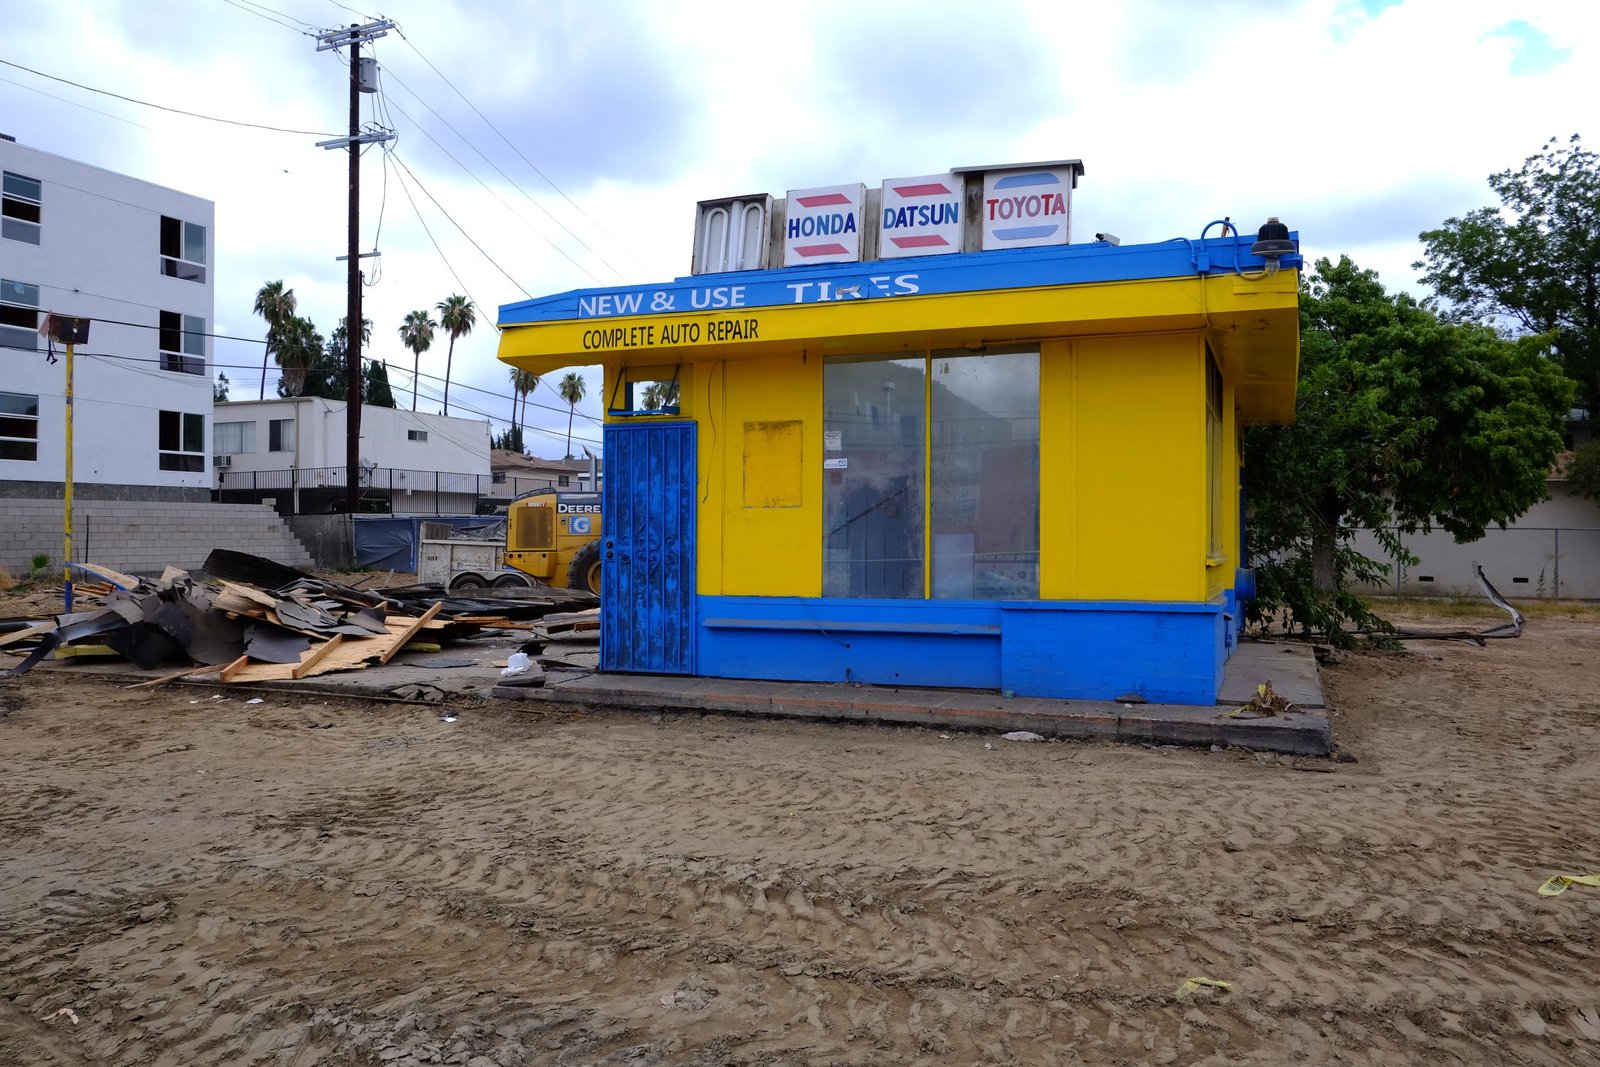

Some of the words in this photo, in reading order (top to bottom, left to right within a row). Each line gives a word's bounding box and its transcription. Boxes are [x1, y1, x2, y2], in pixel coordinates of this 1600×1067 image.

[883, 202, 959, 230] DATSUN
[986, 193, 1065, 221] TOYOTA
[788, 212, 857, 239] HONDA
[579, 291, 643, 317] NEW
[653, 291, 676, 313] &
[691, 286, 746, 309] USE
[583, 325, 654, 350] COMPLETE
[660, 323, 700, 345] AUTO
[707, 319, 759, 342] REPAIR
[558, 503, 601, 513] DEERE
